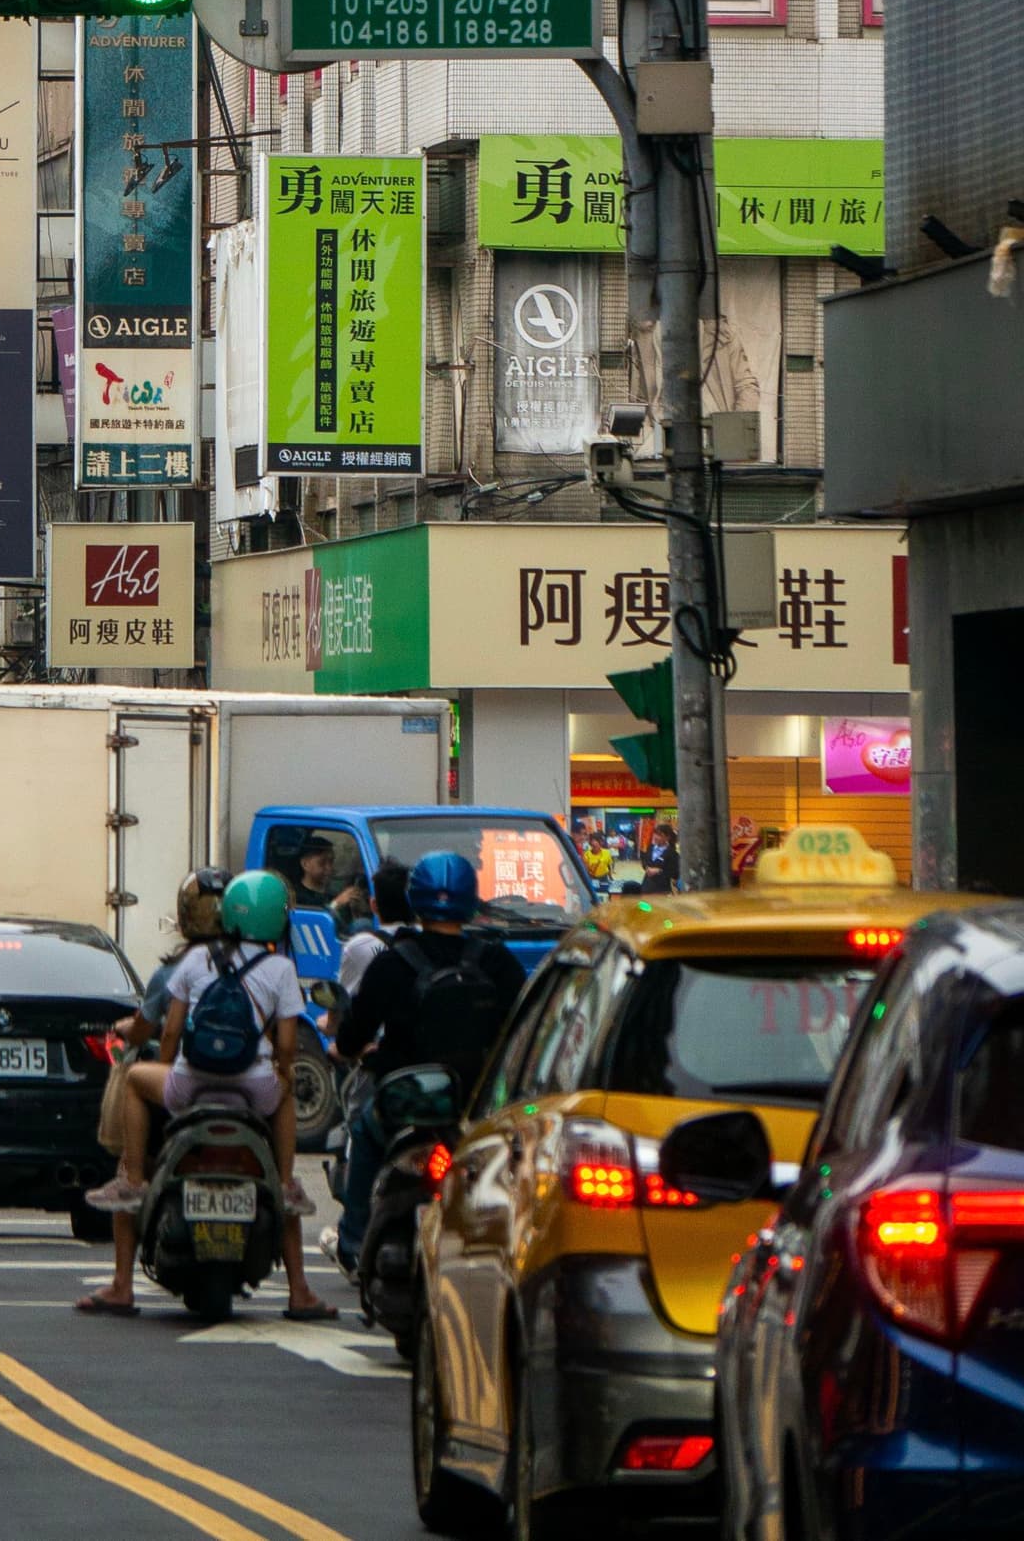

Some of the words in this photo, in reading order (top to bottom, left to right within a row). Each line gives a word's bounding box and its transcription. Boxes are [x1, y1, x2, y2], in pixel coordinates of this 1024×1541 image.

[89, 35, 186, 48] ADVENTURER
[330, 21, 428, 45] 104-186
[454, 21, 553, 44] 188-248
[331, 172, 415, 186] ADVENTURER
[511, 158, 574, 224] 勇
[115, 318, 188, 336] AIGLE
[350, 229, 376, 434] 休閒旅遊專賣店
[505, 356, 589, 377] AIGLE
[86, 450, 189, 478] 請上二樓
[292, 450, 332, 462] AIGLE
[341, 451, 412, 467] 授權經銷商
[519, 568, 848, 650] 阿瘦鞋
[70, 618, 174, 646] 阿瘦皮鞋
[262, 585, 301, 662] 阿瘦皮鞋
[799, 833, 852, 855] 025
